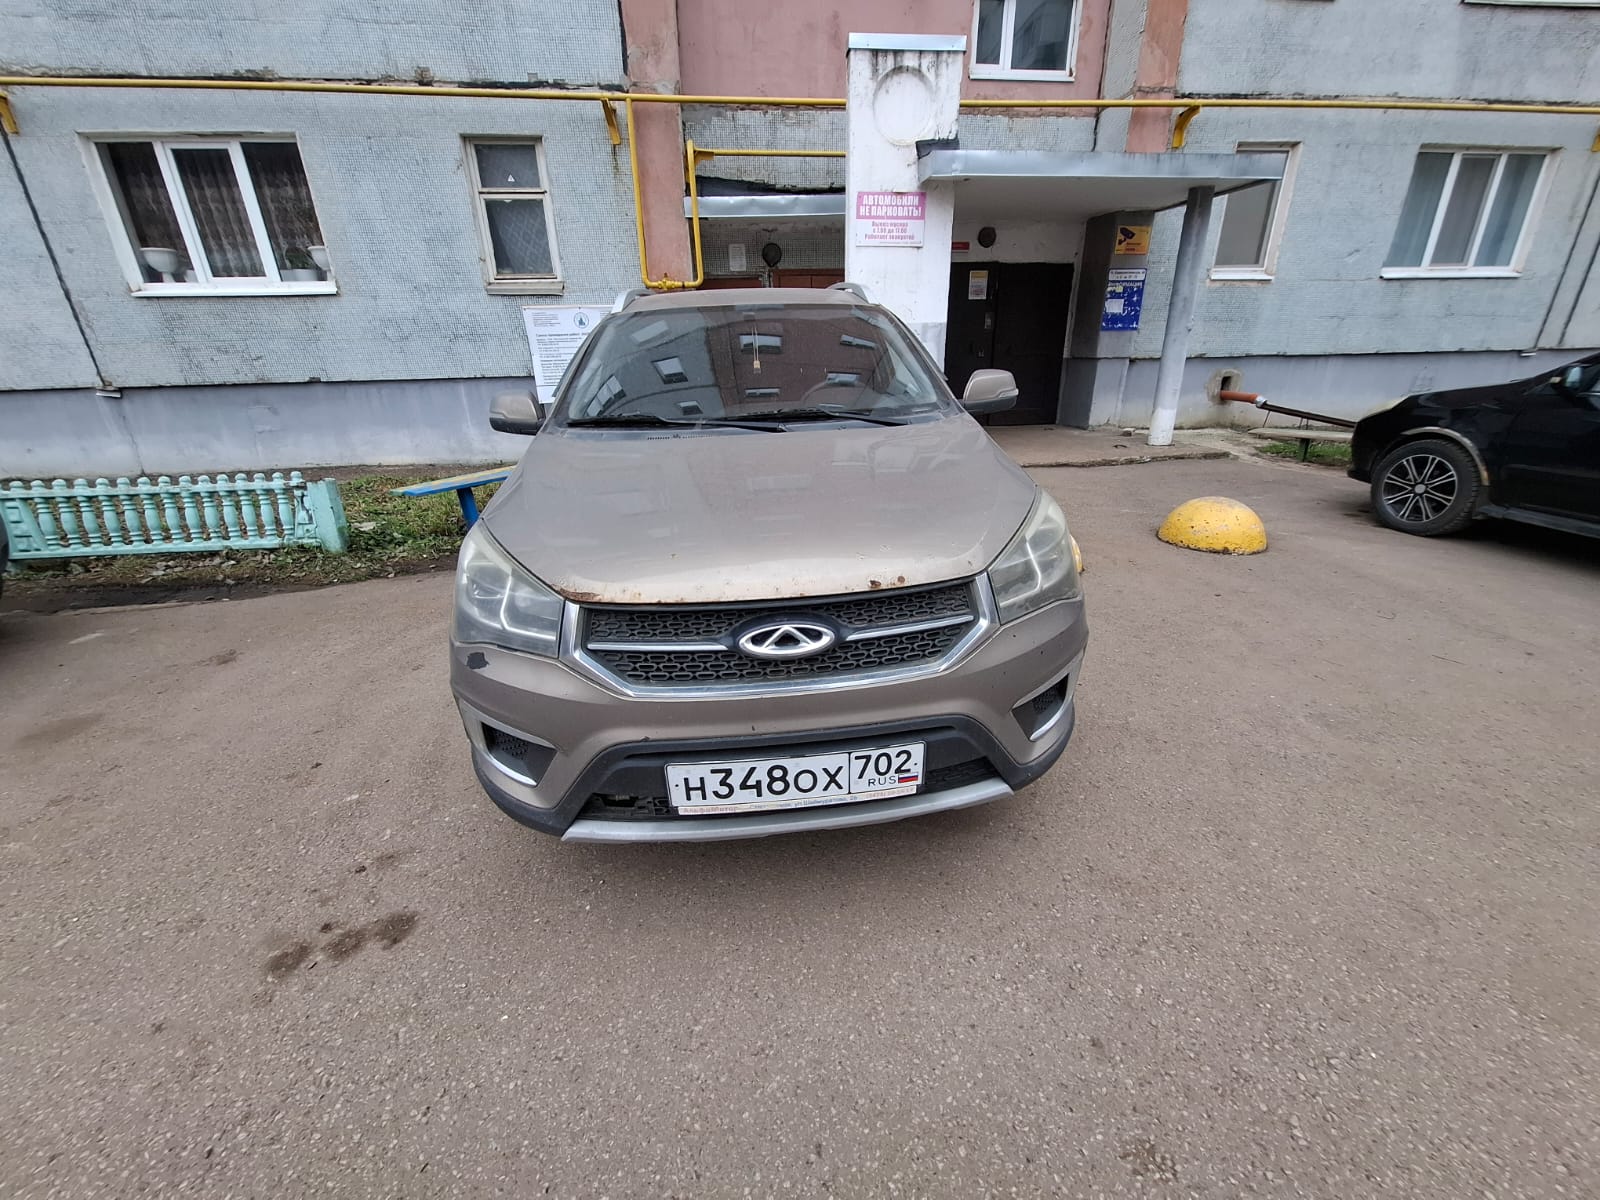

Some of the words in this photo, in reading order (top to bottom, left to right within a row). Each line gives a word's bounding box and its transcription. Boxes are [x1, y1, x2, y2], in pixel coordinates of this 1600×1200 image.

[862, 195, 919, 206] АВТОМОБИЛИ
[859, 206, 870, 216] НЕ
[871, 206, 922, 216] ПАРКОВАТЬ!
[855, 750, 912, 780] 702
[868, 776, 897, 787] RUS
